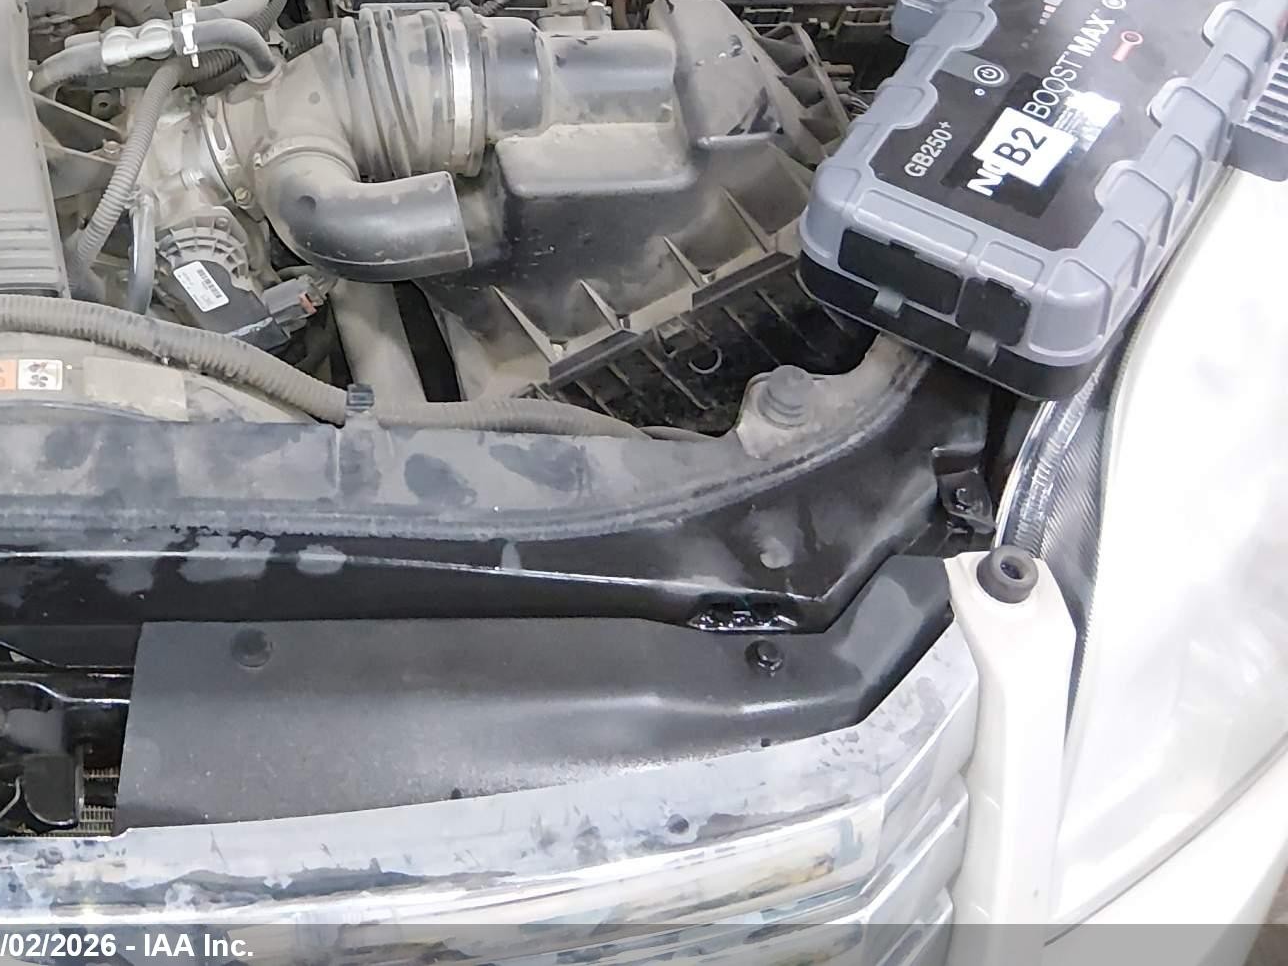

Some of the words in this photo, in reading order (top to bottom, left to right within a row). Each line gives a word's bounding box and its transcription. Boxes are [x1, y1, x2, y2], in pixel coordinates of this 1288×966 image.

[1022, 53, 1085, 119] BOOST
[1067, 12, 1116, 62] MAX
[904, 120, 953, 178] GB250+
[993, 127, 1048, 167] B2
